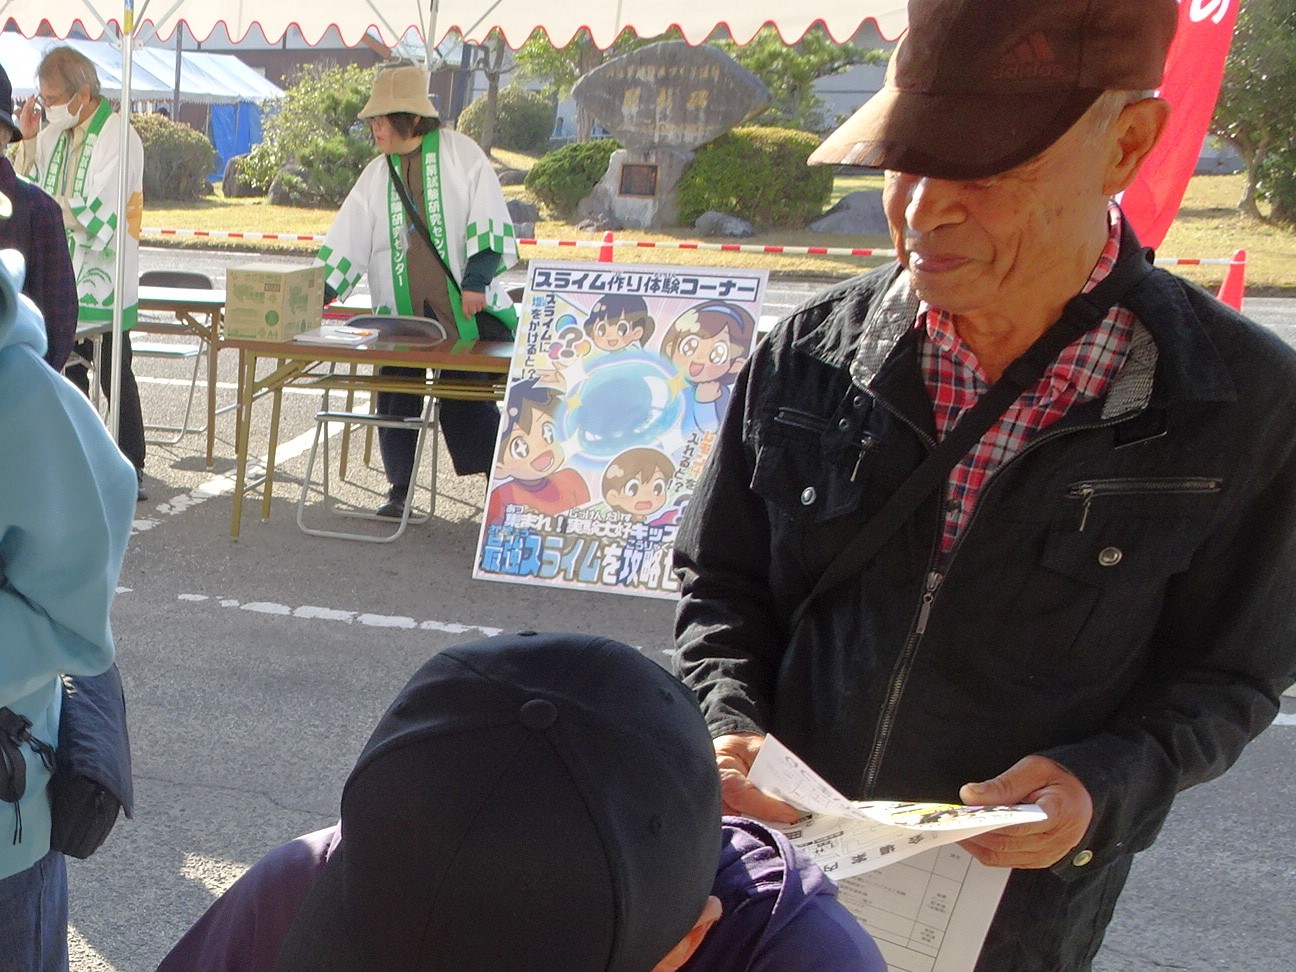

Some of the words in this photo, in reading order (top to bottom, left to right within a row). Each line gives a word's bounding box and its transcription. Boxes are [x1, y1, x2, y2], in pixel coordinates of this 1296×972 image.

[535, 270, 755, 297] スライム作り体験コーナー
[539, 293, 556, 354] スライムに
